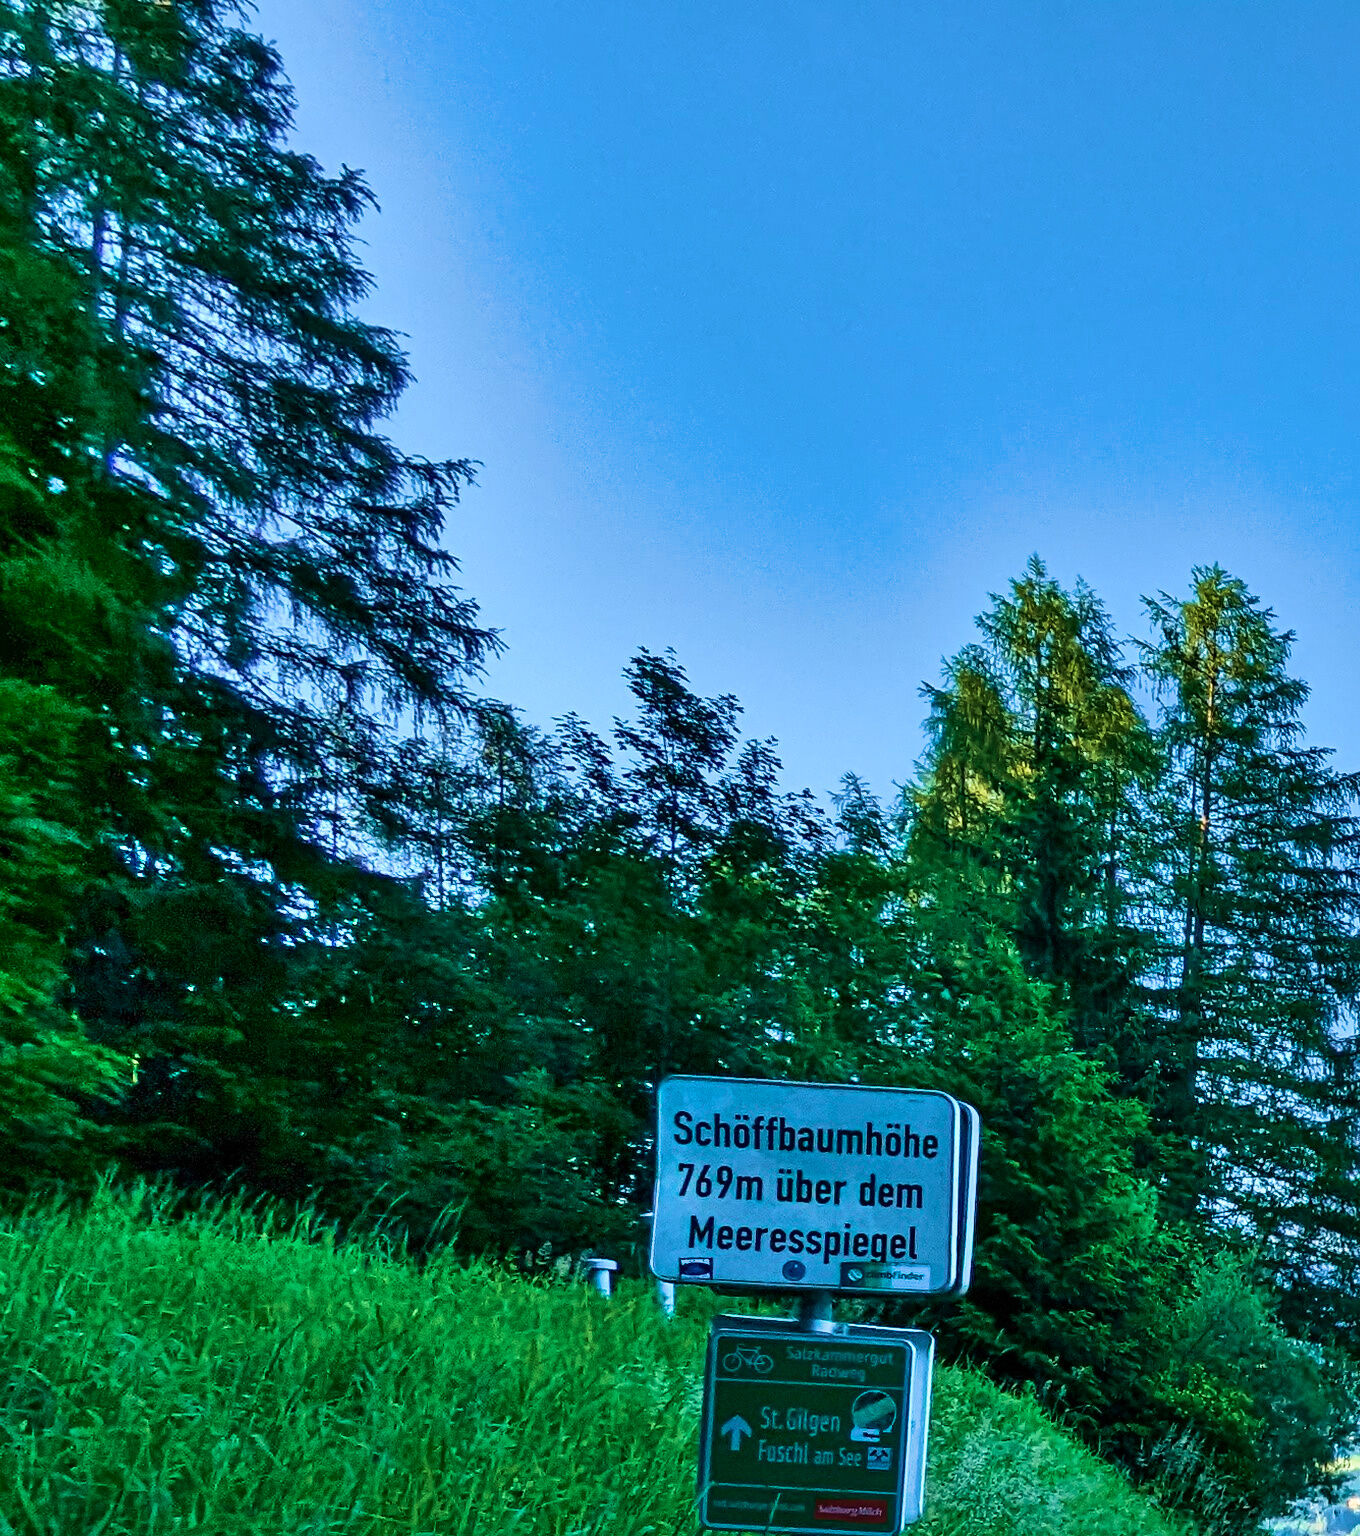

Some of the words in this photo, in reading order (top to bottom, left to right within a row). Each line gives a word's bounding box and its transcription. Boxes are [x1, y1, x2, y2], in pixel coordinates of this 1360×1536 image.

[673, 1110, 939, 1159] Schöffbaumhöhe
[677, 1163, 763, 1201] 769m
[776, 1168, 847, 1205] über
[859, 1173, 924, 1208] dem
[688, 1214, 918, 1265] Meeresspiegel
[785, 1345, 895, 1367] Salzkammergut
[811, 1363, 866, 1383] Radweg
[786, 1407, 841, 1437] Gilgen
[757, 1438, 809, 1465] Fuschl
[813, 1449, 834, 1465] am
[838, 1447, 862, 1468] See
